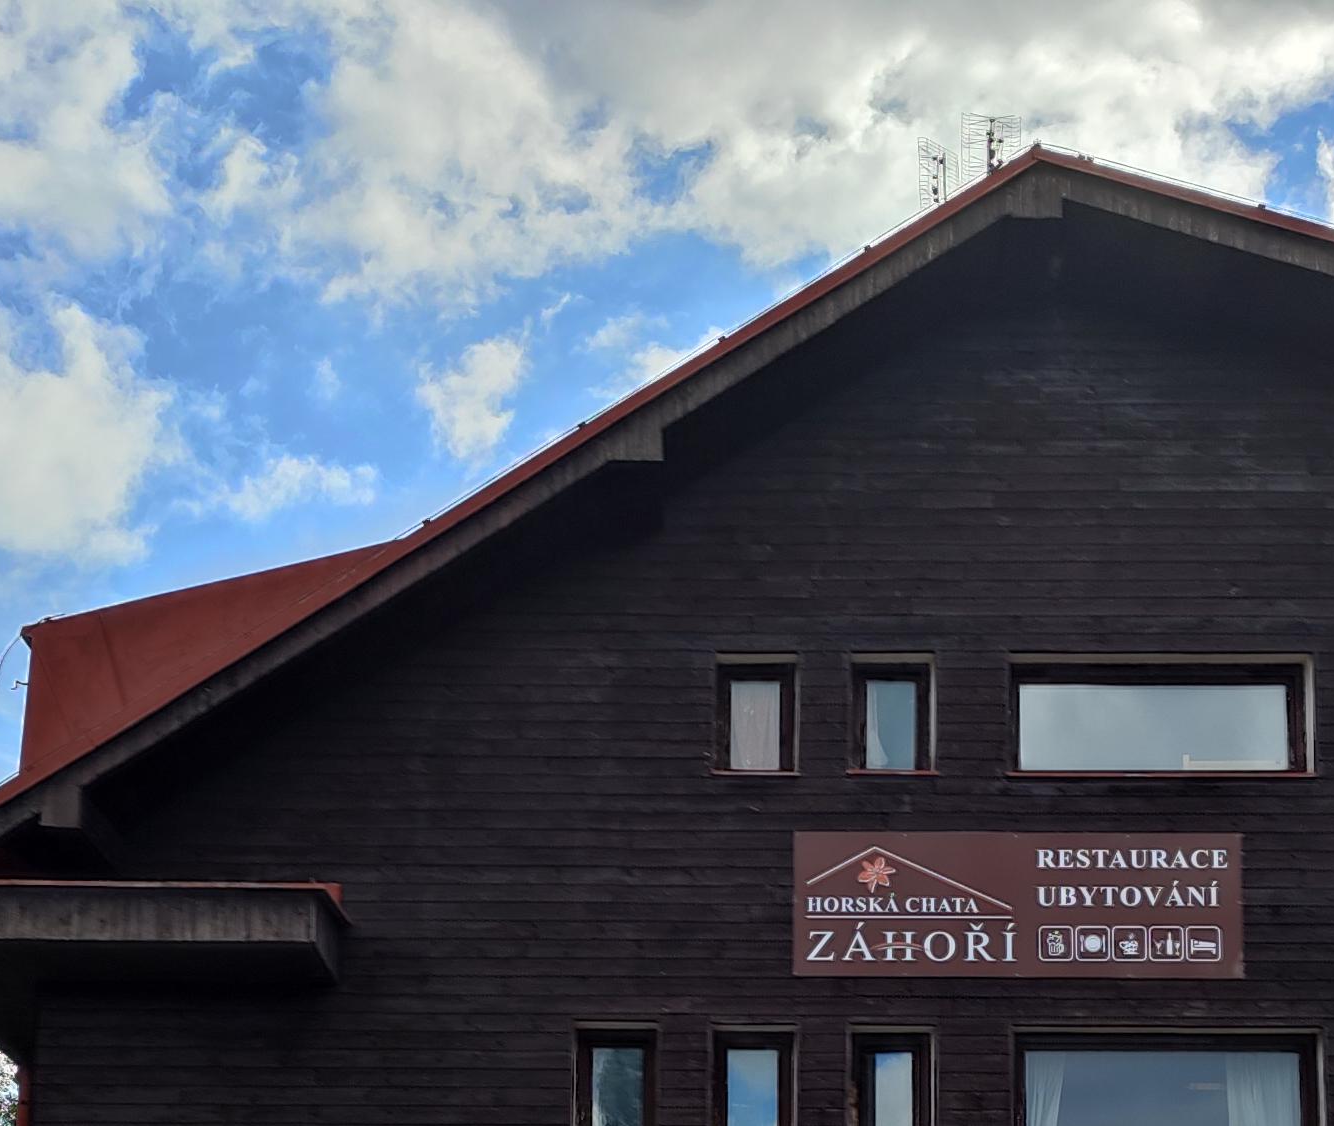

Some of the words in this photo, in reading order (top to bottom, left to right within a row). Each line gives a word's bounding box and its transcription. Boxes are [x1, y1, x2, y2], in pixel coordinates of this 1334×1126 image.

[1037, 847, 1228, 869] RESTAURACE
[807, 892, 898, 914] HORSKÁ
[905, 897, 980, 914] CHATA
[1037, 881, 1219, 907] UBYTOVÁNÍ
[807, 922, 1017, 961] ZÁHOŘÍ
